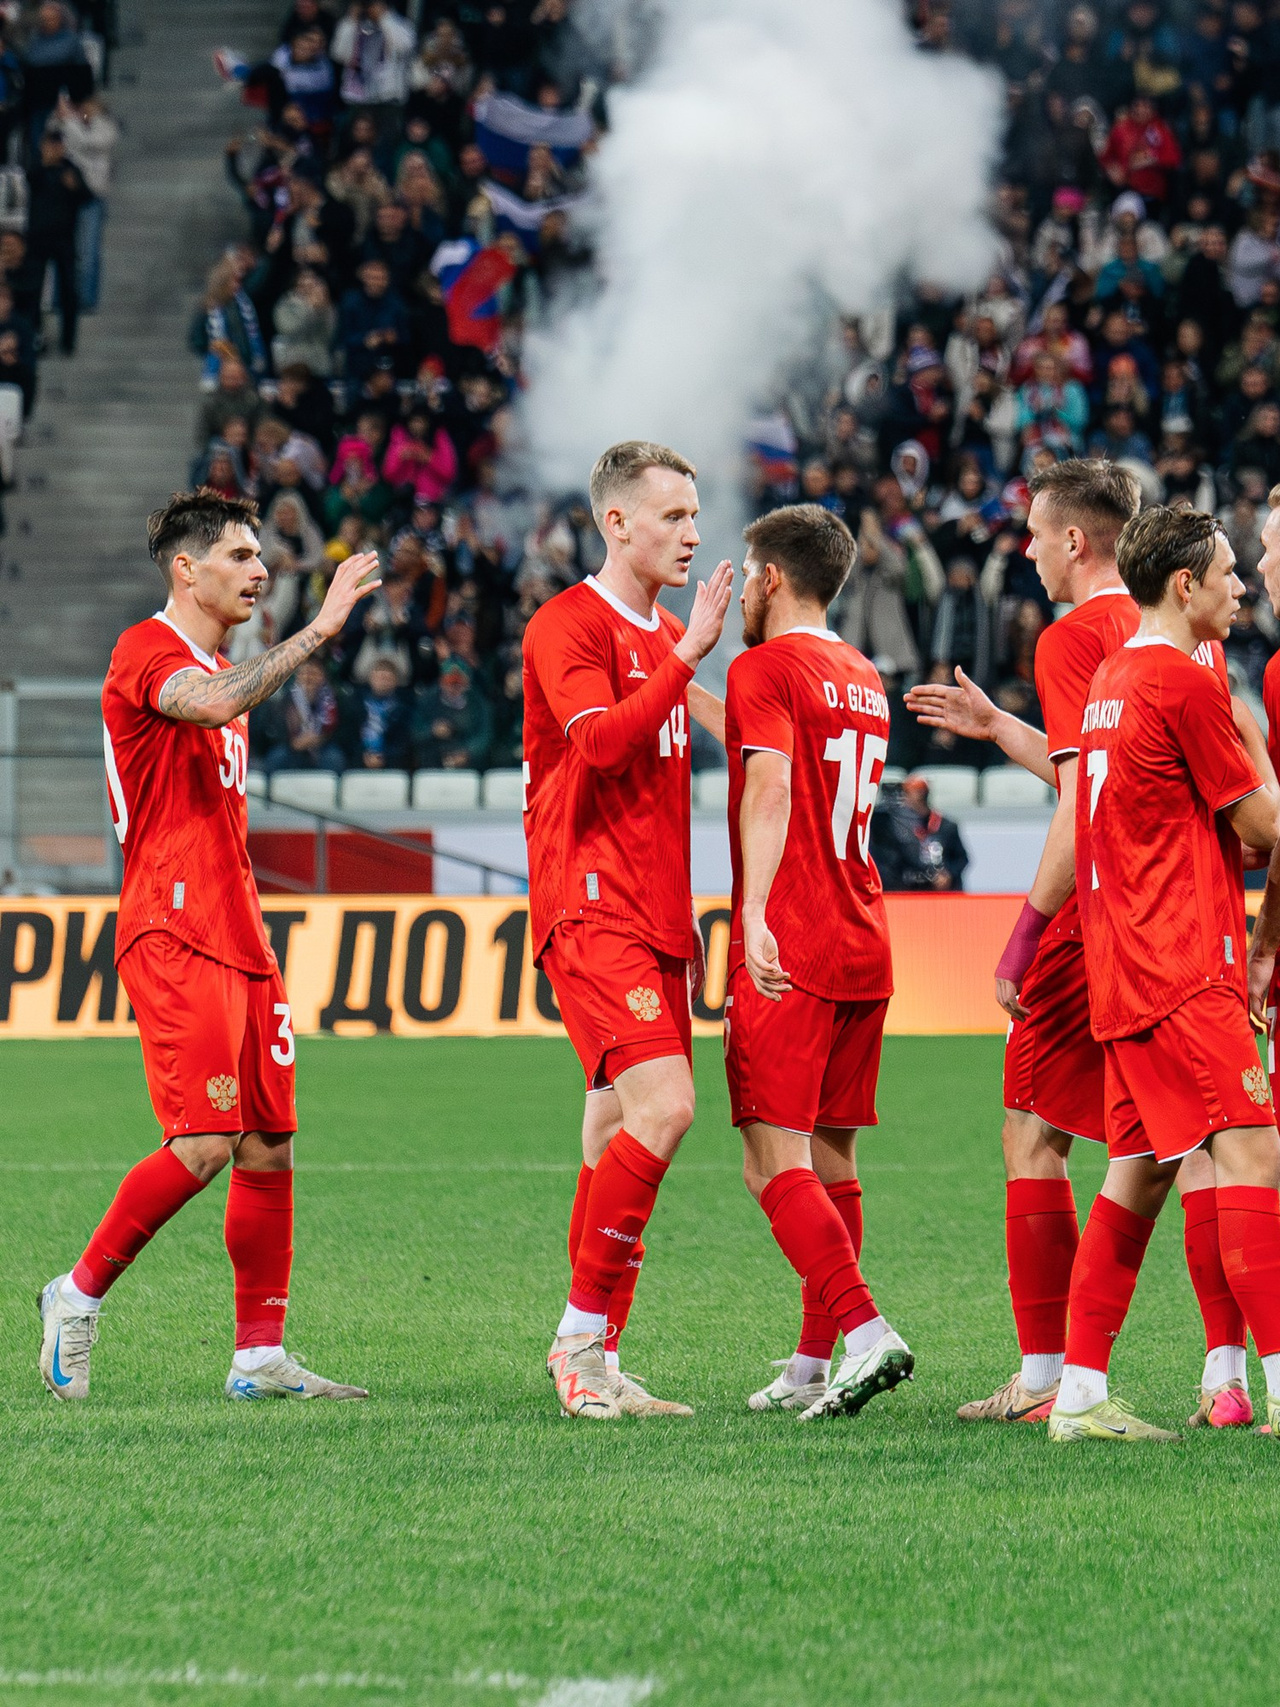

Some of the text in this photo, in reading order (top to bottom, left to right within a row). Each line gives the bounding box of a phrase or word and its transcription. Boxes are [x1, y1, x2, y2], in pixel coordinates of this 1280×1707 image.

[823, 681, 845, 709] D.
[219, 725, 247, 796] 30
[658, 704, 687, 758] 14
[823, 728, 888, 868] 15
[319, 910, 467, 1031] ДО
